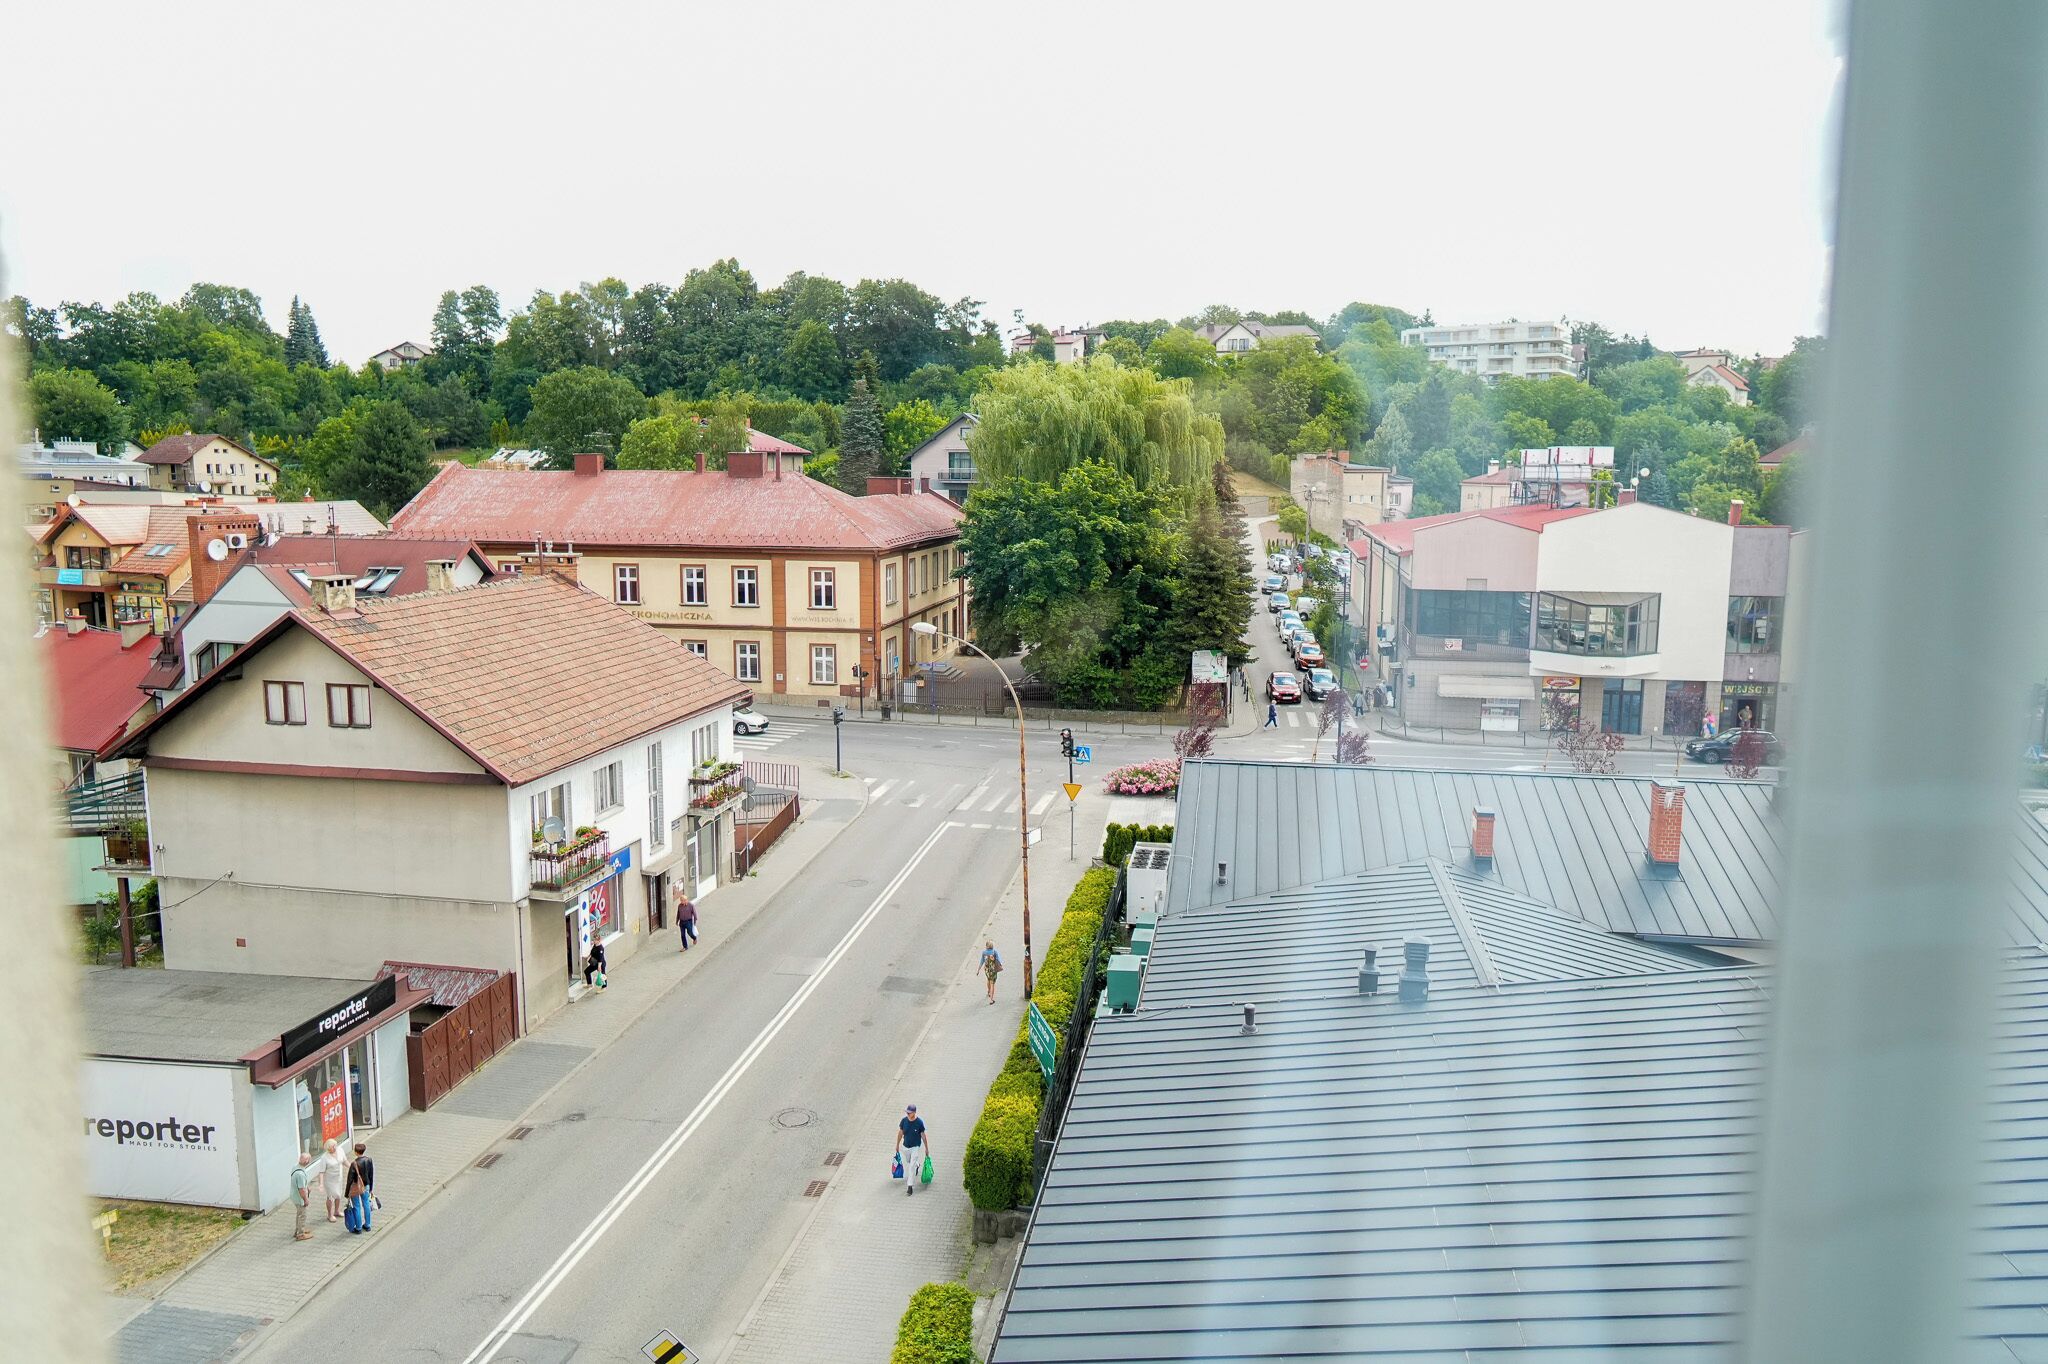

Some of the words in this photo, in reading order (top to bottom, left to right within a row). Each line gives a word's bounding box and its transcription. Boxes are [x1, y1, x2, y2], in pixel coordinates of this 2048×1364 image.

[319, 997, 367, 1033] reporter
[323, 1087, 342, 1107] SALE
[83, 1116, 216, 1145] reporter
[129, 1140, 153, 1148] MADE
[179, 1143, 217, 1152] STORIES
